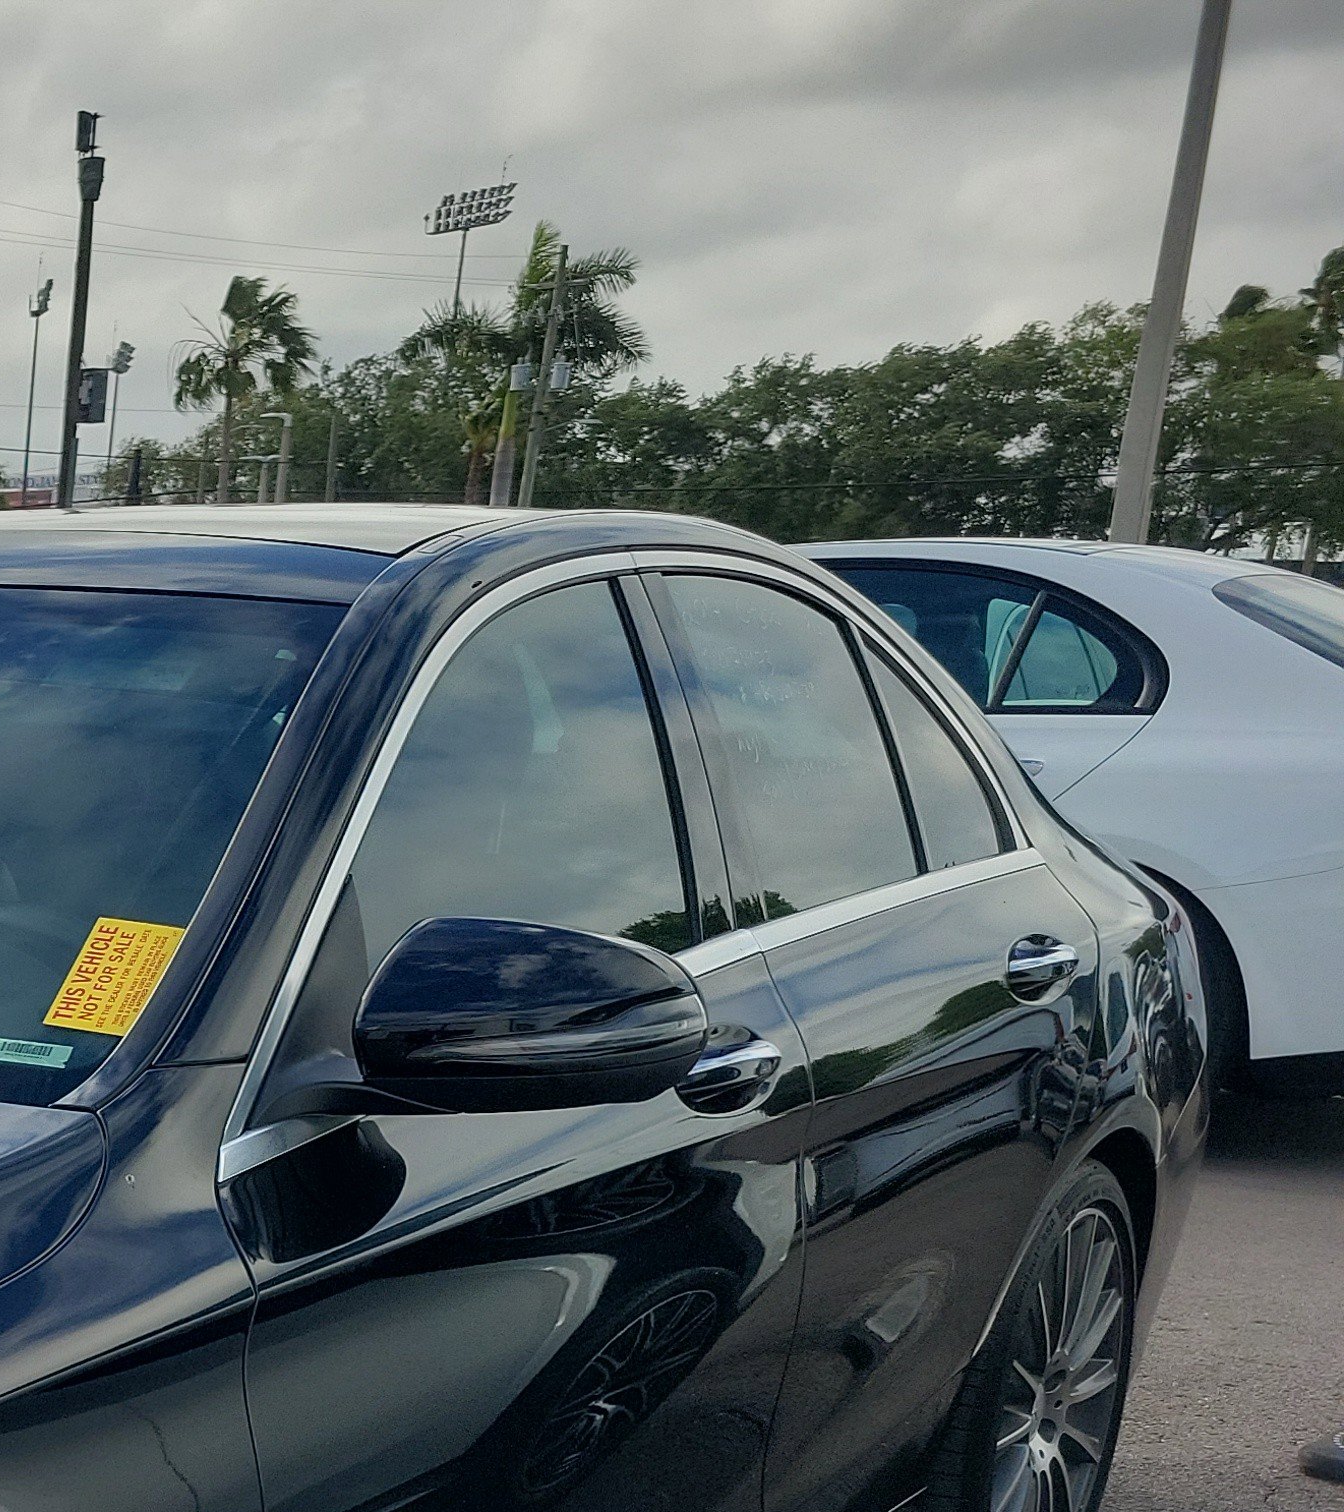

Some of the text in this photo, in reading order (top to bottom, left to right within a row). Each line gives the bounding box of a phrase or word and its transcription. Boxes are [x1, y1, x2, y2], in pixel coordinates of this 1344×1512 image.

[52, 925, 119, 1018] THIS VEHICLE
[78, 932, 136, 1020] NOT FOR SALE
